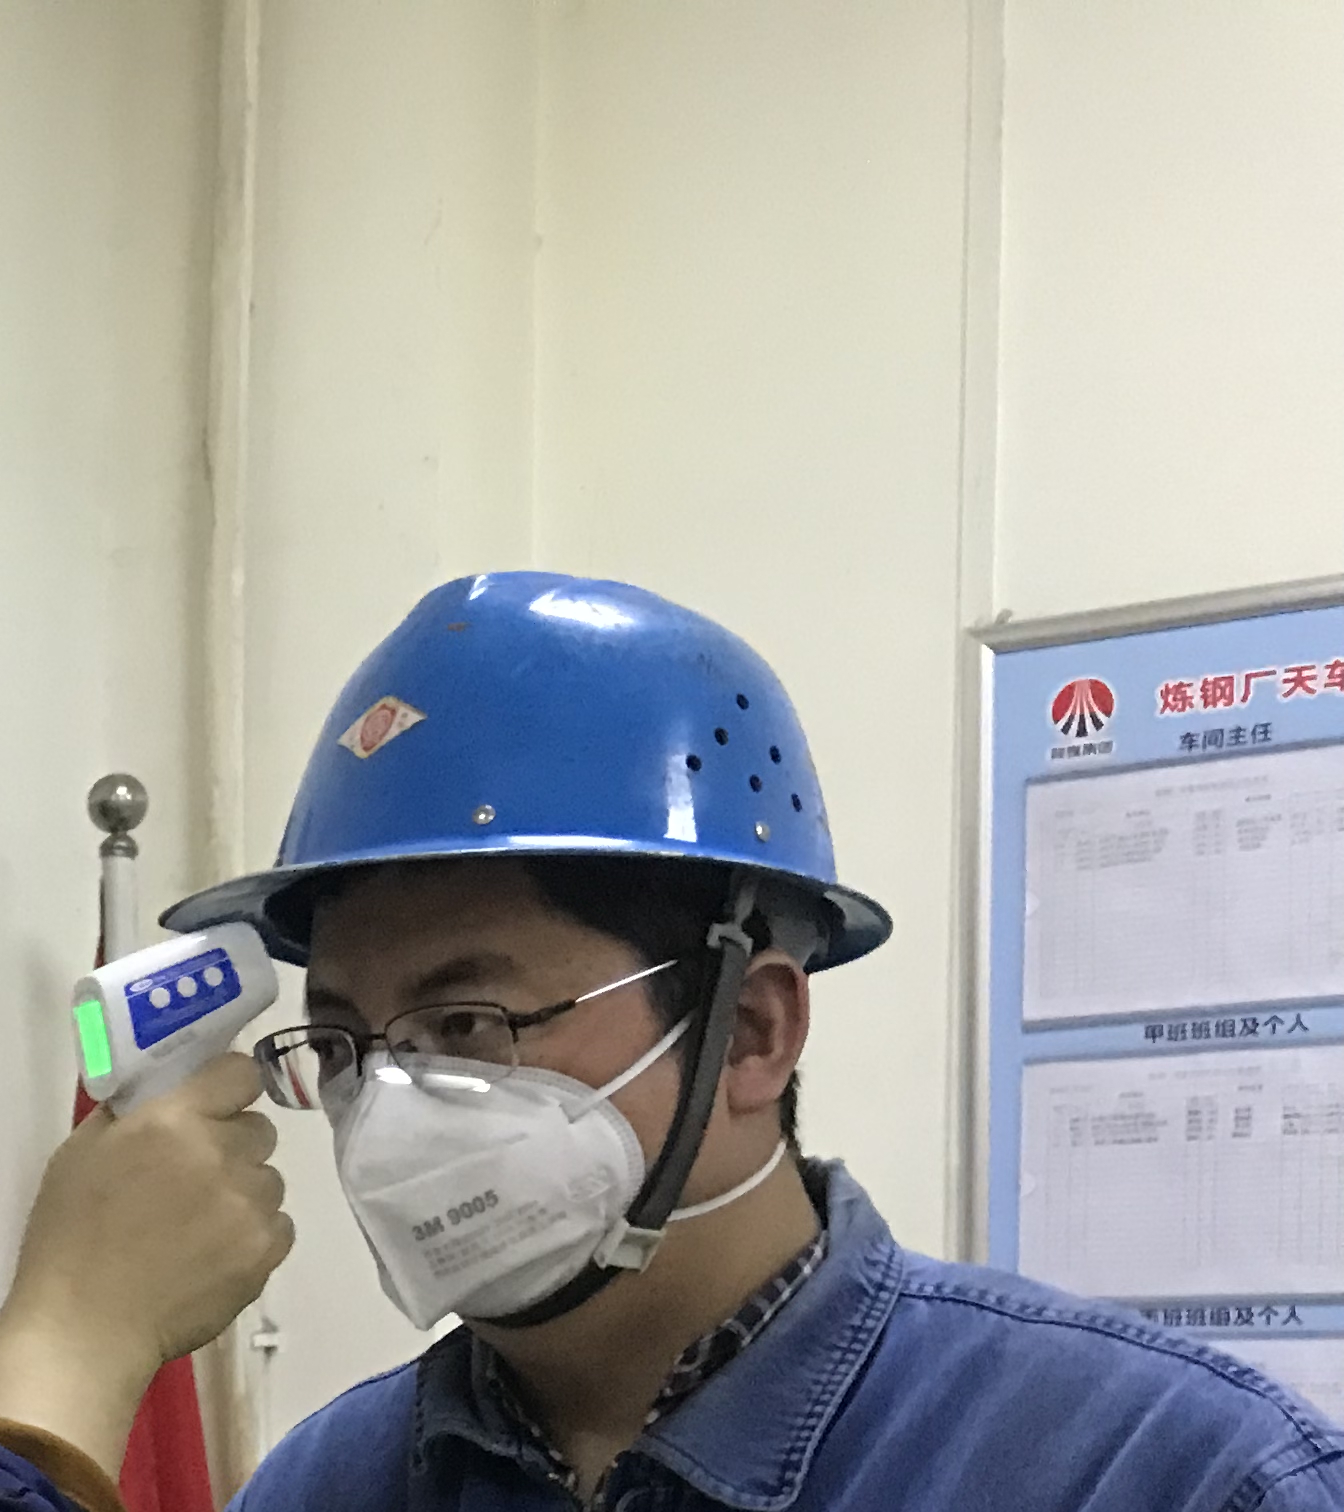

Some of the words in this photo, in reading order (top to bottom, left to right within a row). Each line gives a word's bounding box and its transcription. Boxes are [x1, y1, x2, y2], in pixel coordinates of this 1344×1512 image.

[1179, 722, 1273, 751] 车间主任
[412, 1217, 445, 1242] 3M
[446, 1189, 499, 1226] 9005
